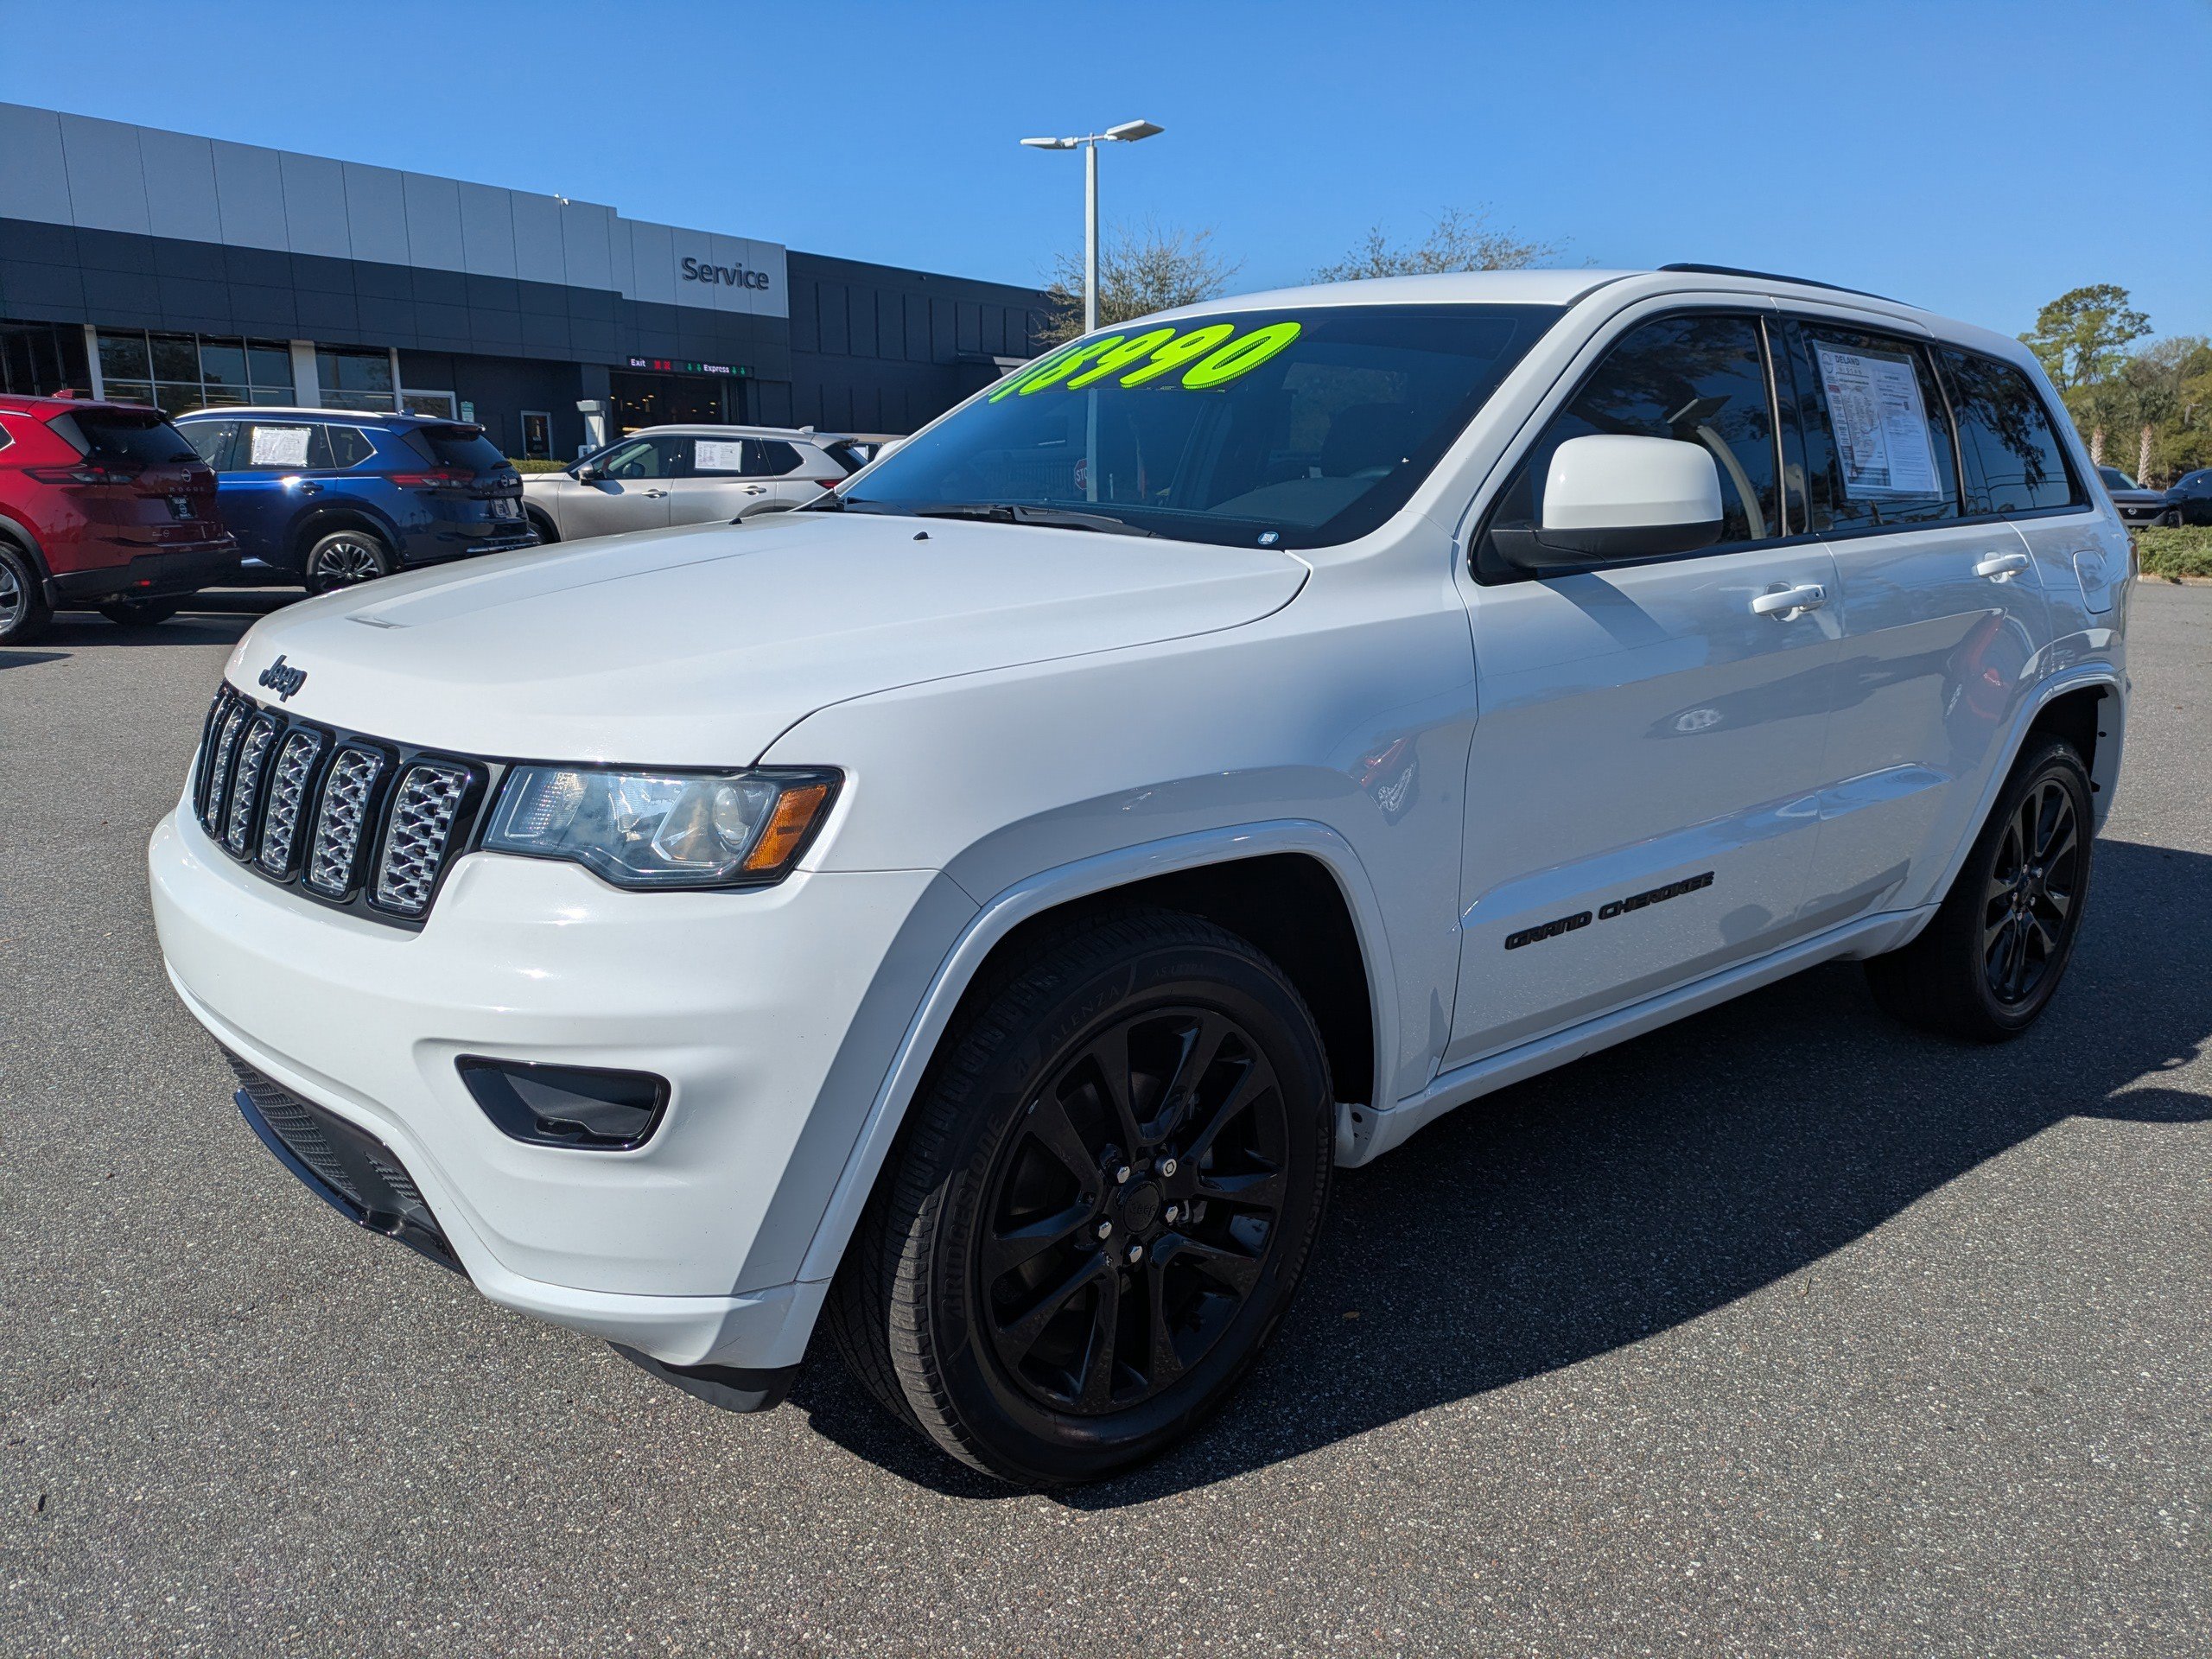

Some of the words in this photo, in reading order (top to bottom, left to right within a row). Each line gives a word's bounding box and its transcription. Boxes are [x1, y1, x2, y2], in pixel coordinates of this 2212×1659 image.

[682, 257, 769, 290] Service
[630, 359, 646, 367] Exit
[702, 364, 730, 373] Express
[1076, 467, 1088, 482] STO
[258, 654, 308, 703] Jeep
[1504, 910, 1593, 950] GRAND
[1598, 870, 1716, 920] CHEROKEE
[1050, 983, 1122, 1046] ALENZA
[941, 1112, 1006, 1321] BRIDGESTONE
